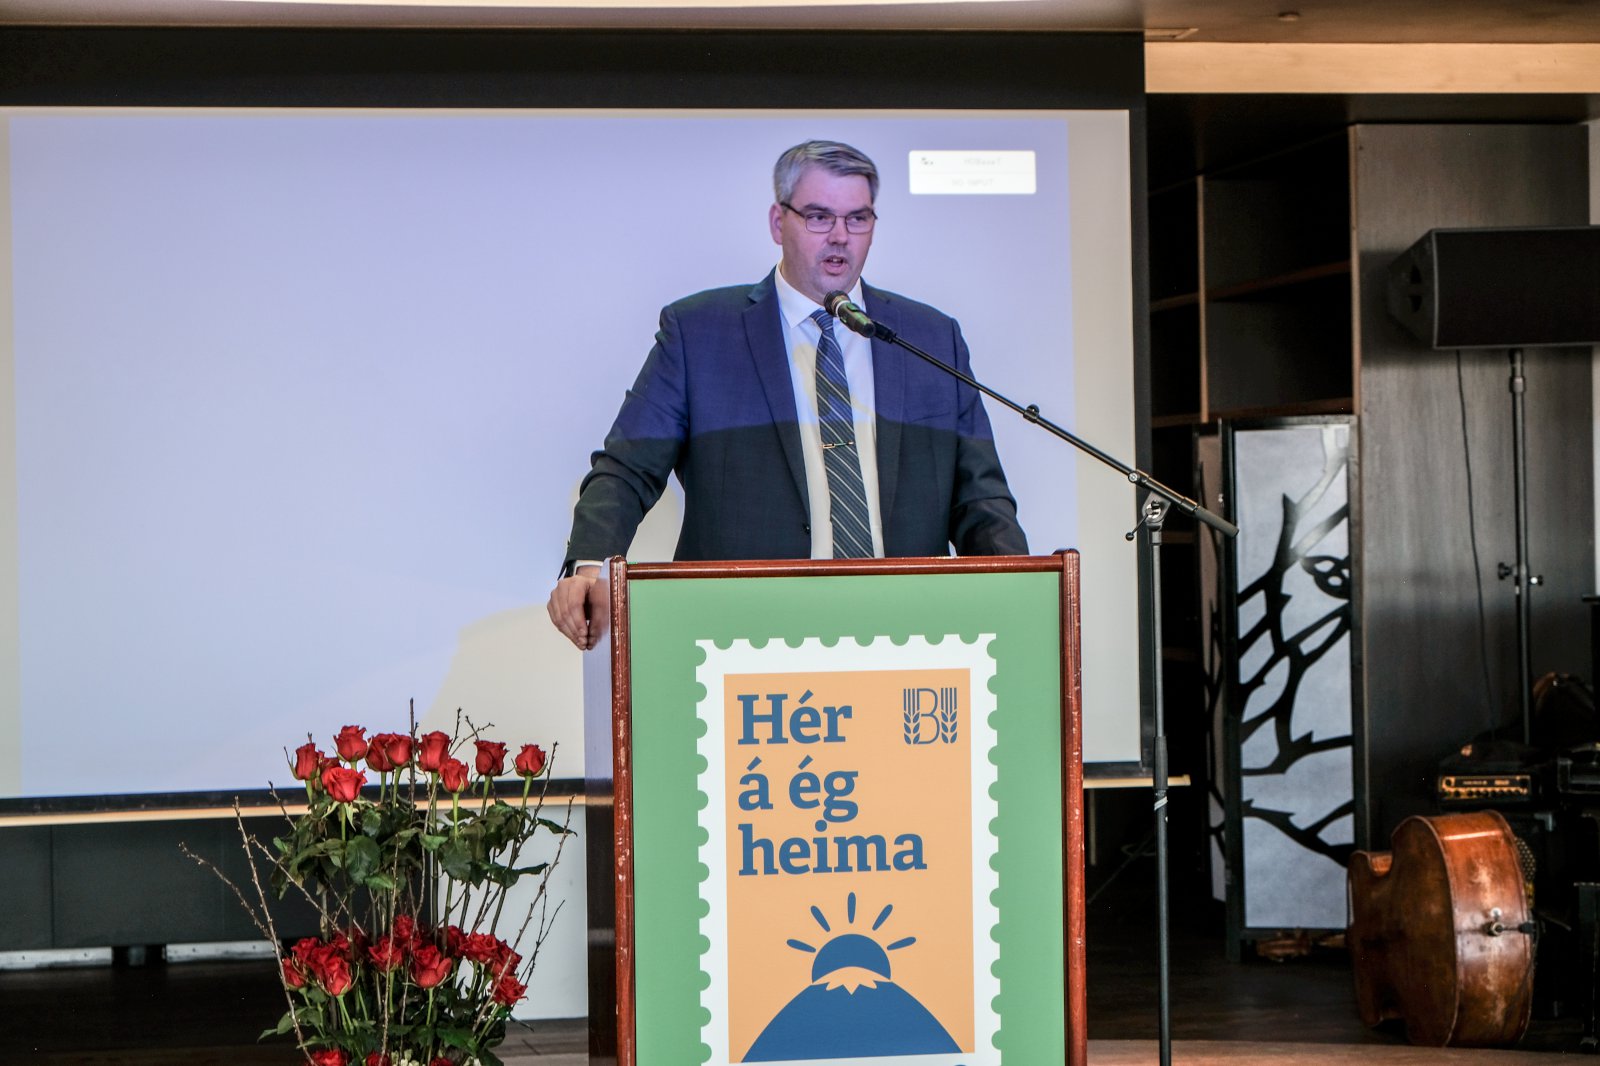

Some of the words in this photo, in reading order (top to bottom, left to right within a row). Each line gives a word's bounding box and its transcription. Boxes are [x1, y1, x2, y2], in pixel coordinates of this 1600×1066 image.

[737, 689, 853, 745] Hér
[738, 756, 774, 811] á
[789, 755, 859, 823] ég
[738, 819, 928, 876] heima
